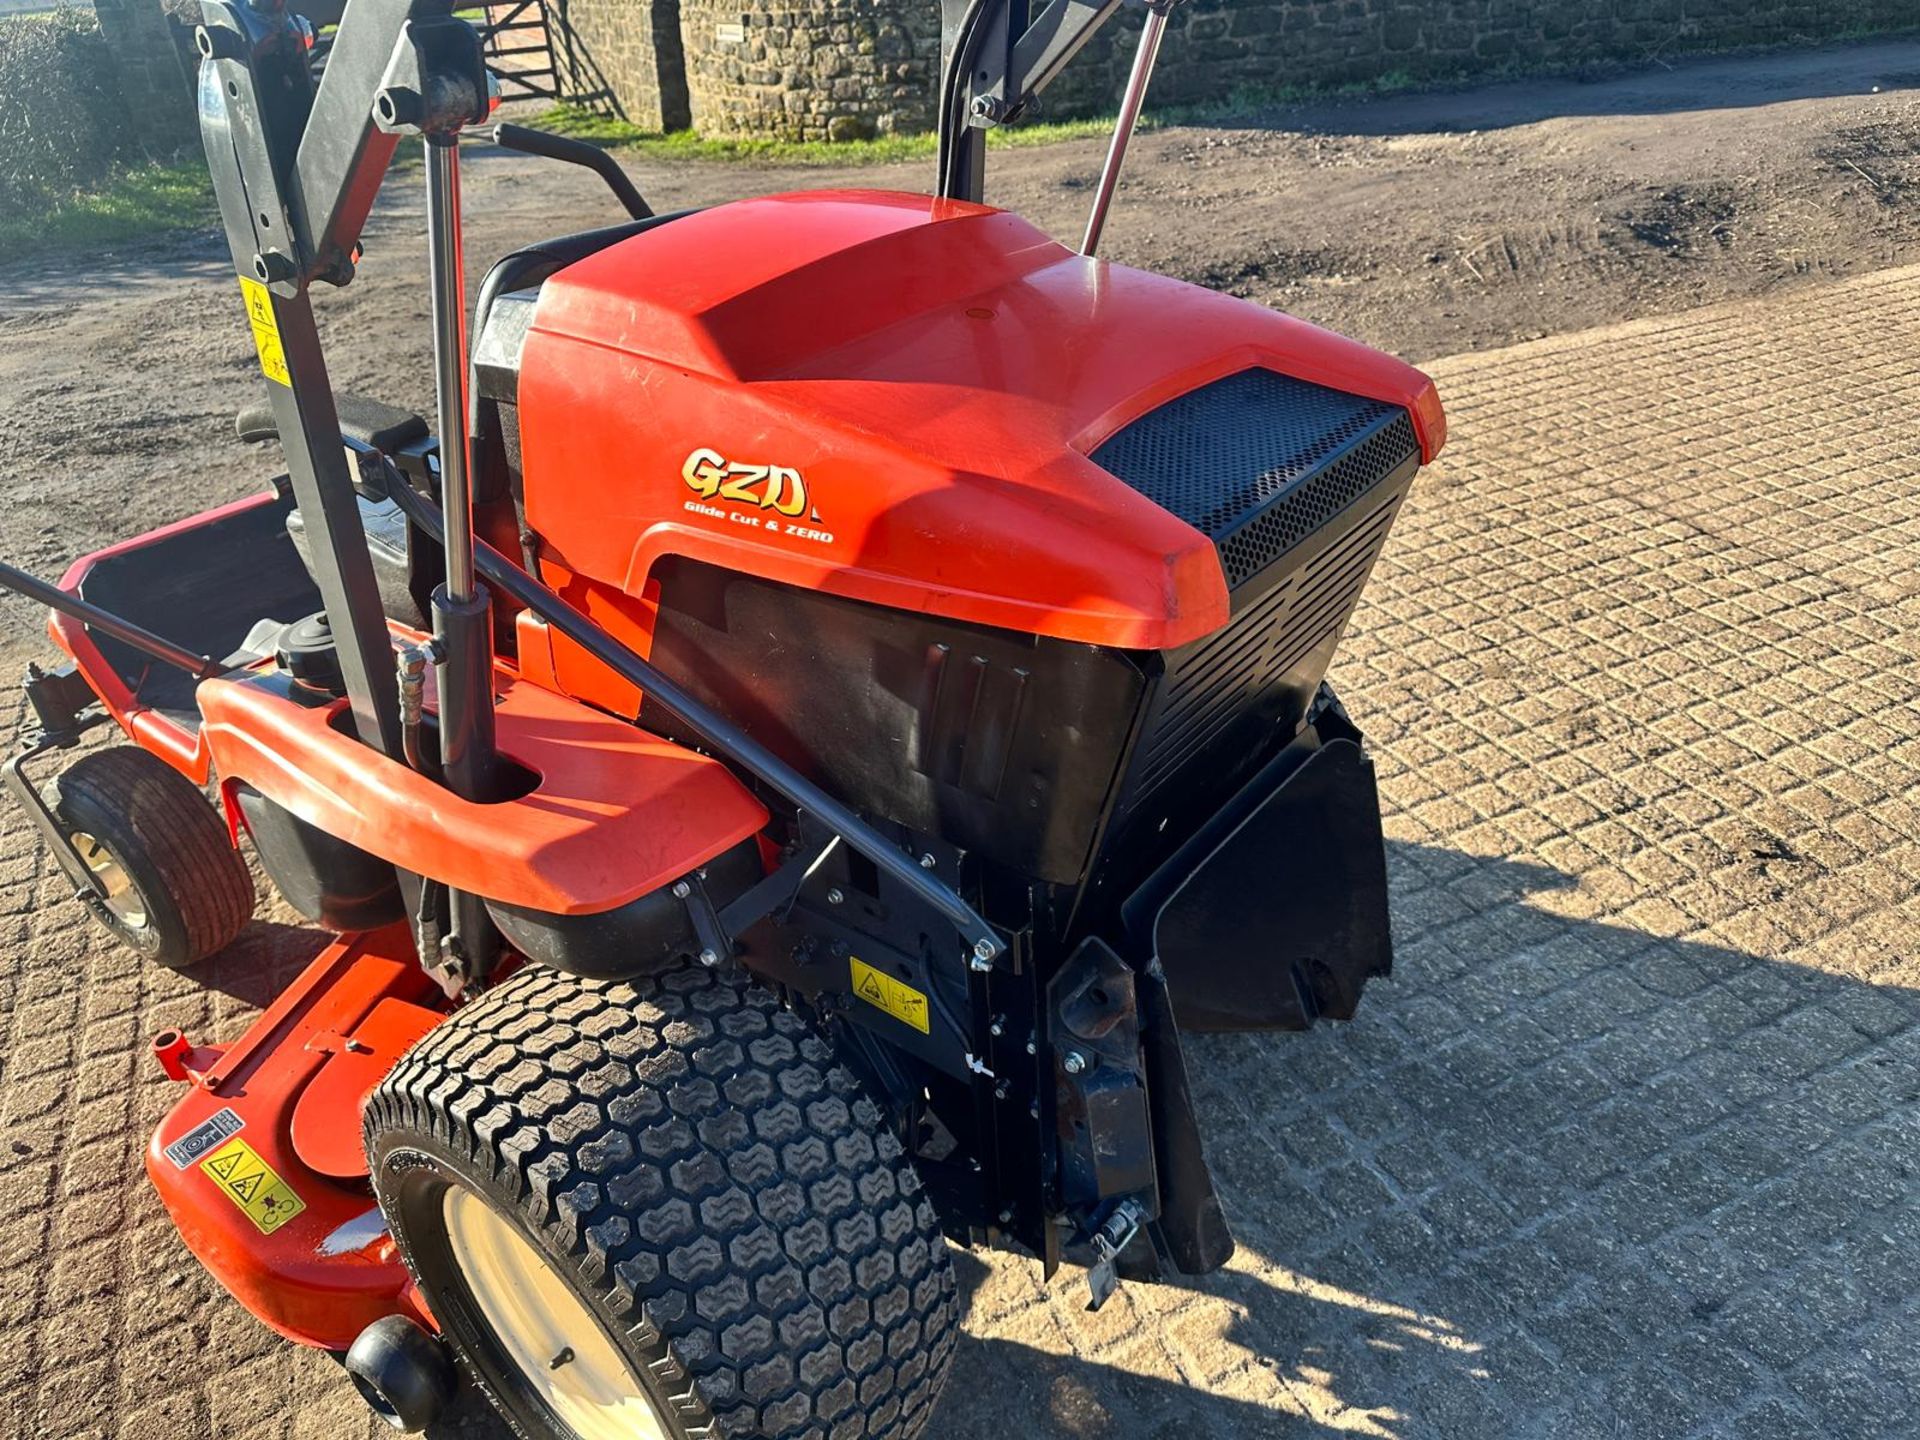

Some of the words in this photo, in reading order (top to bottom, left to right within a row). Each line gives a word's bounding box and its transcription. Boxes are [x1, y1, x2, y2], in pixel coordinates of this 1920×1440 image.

[684, 501, 726, 519] Glide
[730, 511, 760, 527] Cut
[765, 520, 779, 532] &
[785, 524, 834, 543] ZERO
